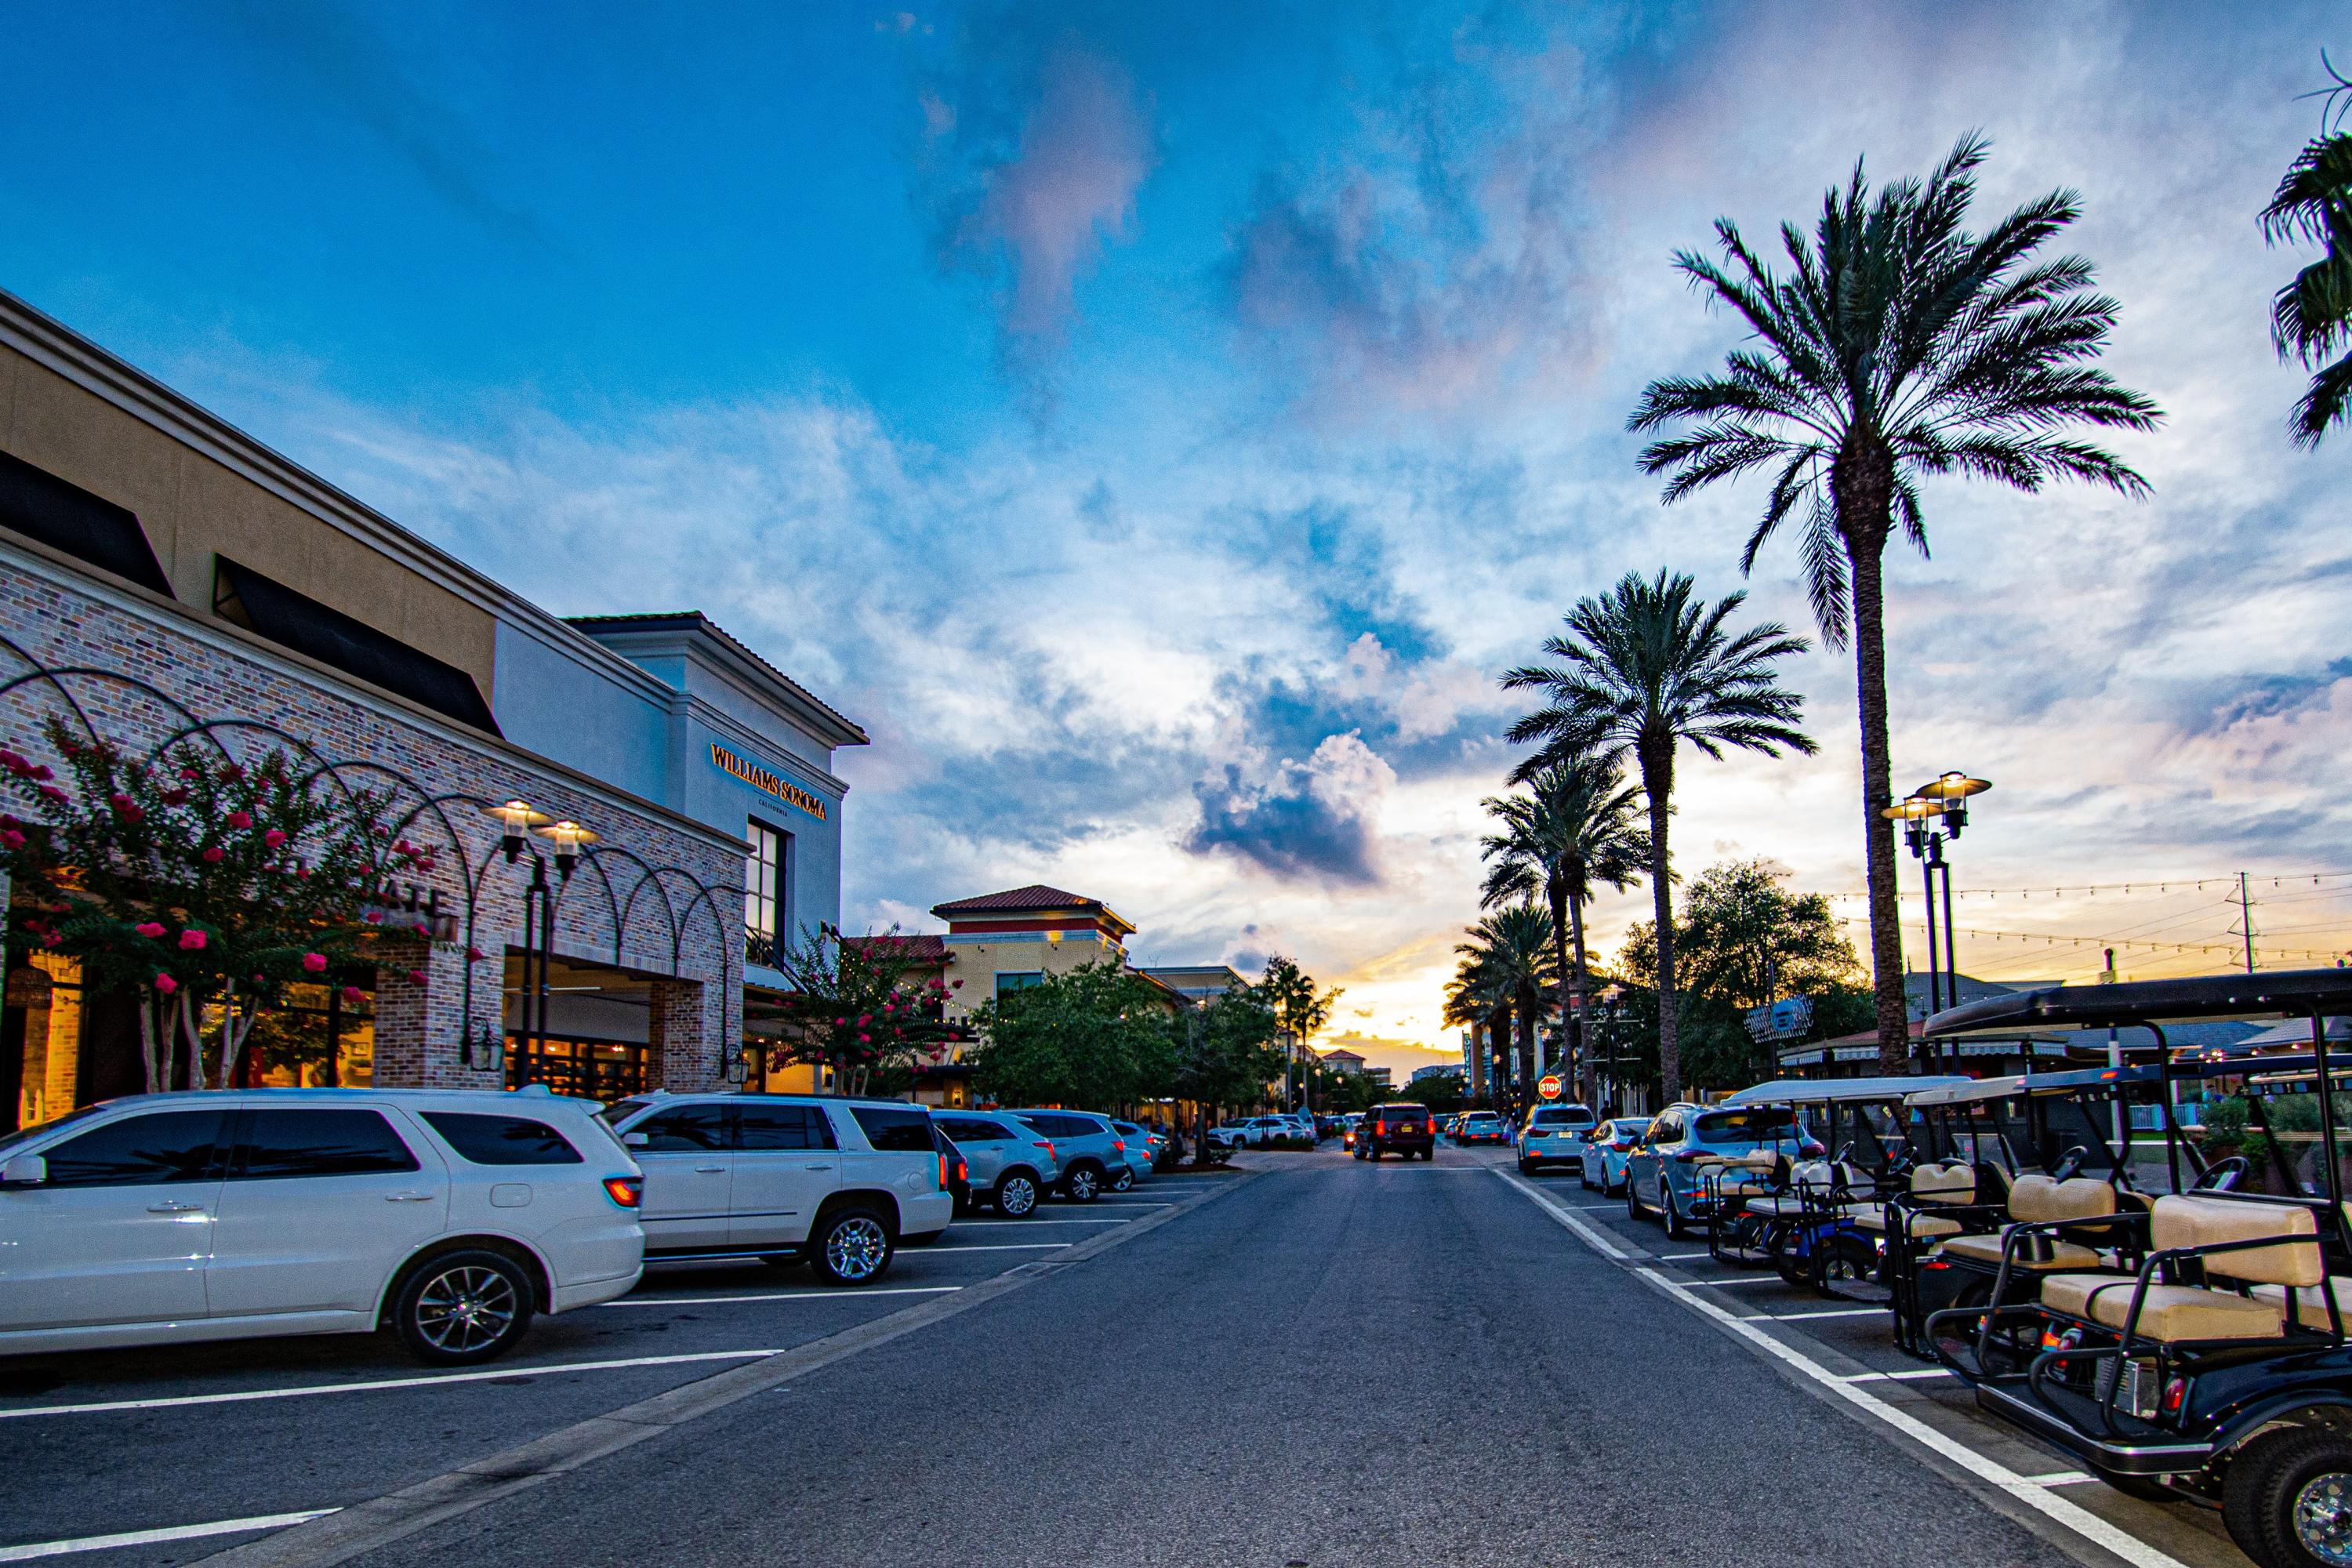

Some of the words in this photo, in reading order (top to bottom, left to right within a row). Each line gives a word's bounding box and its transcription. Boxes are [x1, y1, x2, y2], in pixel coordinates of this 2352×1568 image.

[711, 742, 779, 796] WILLIAMS
[780, 779, 827, 820] SONOMA
[758, 799, 788, 817] CALIFORNIA
[1541, 1083, 1559, 1092] STOP
